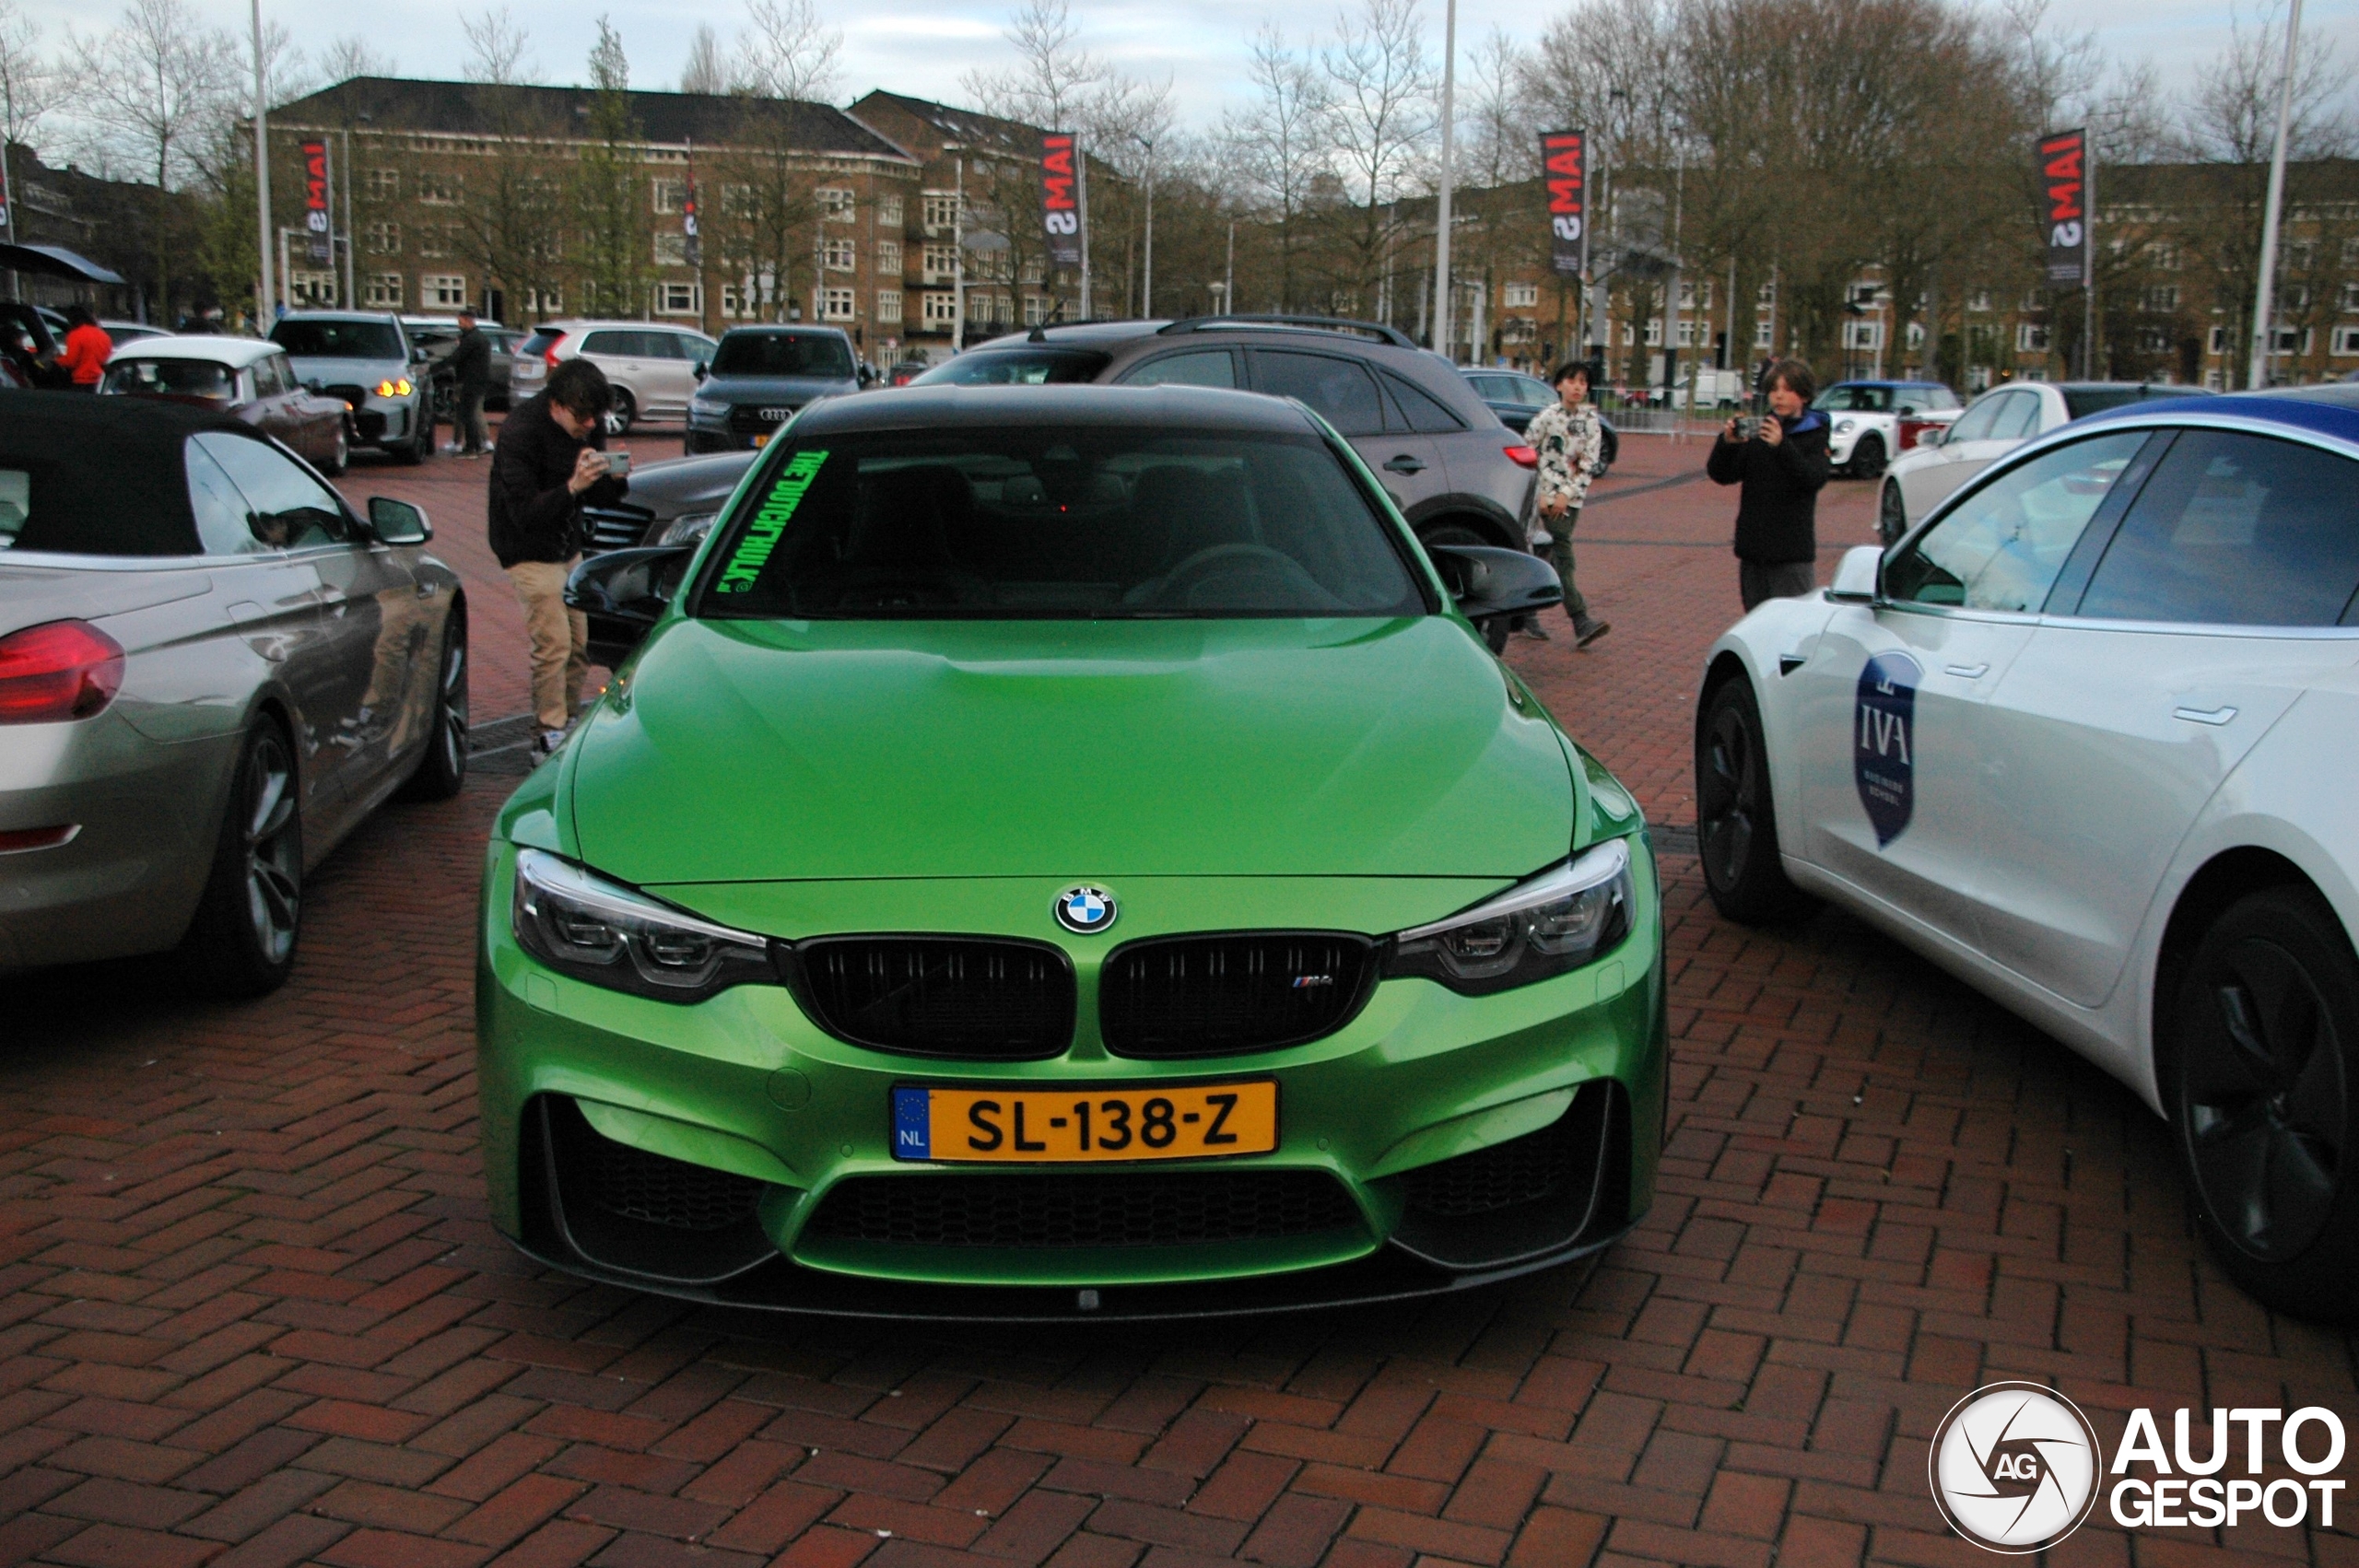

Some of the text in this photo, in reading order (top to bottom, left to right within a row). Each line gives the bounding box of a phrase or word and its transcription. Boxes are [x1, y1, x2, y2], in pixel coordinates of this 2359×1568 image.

[784, 450, 829, 478] THE
[722, 532, 777, 583] HULK
[1860, 704, 1911, 766] IVA
[1062, 887, 1111, 903] BMW
[900, 1093, 1238, 1153] NL SL-138-Z
